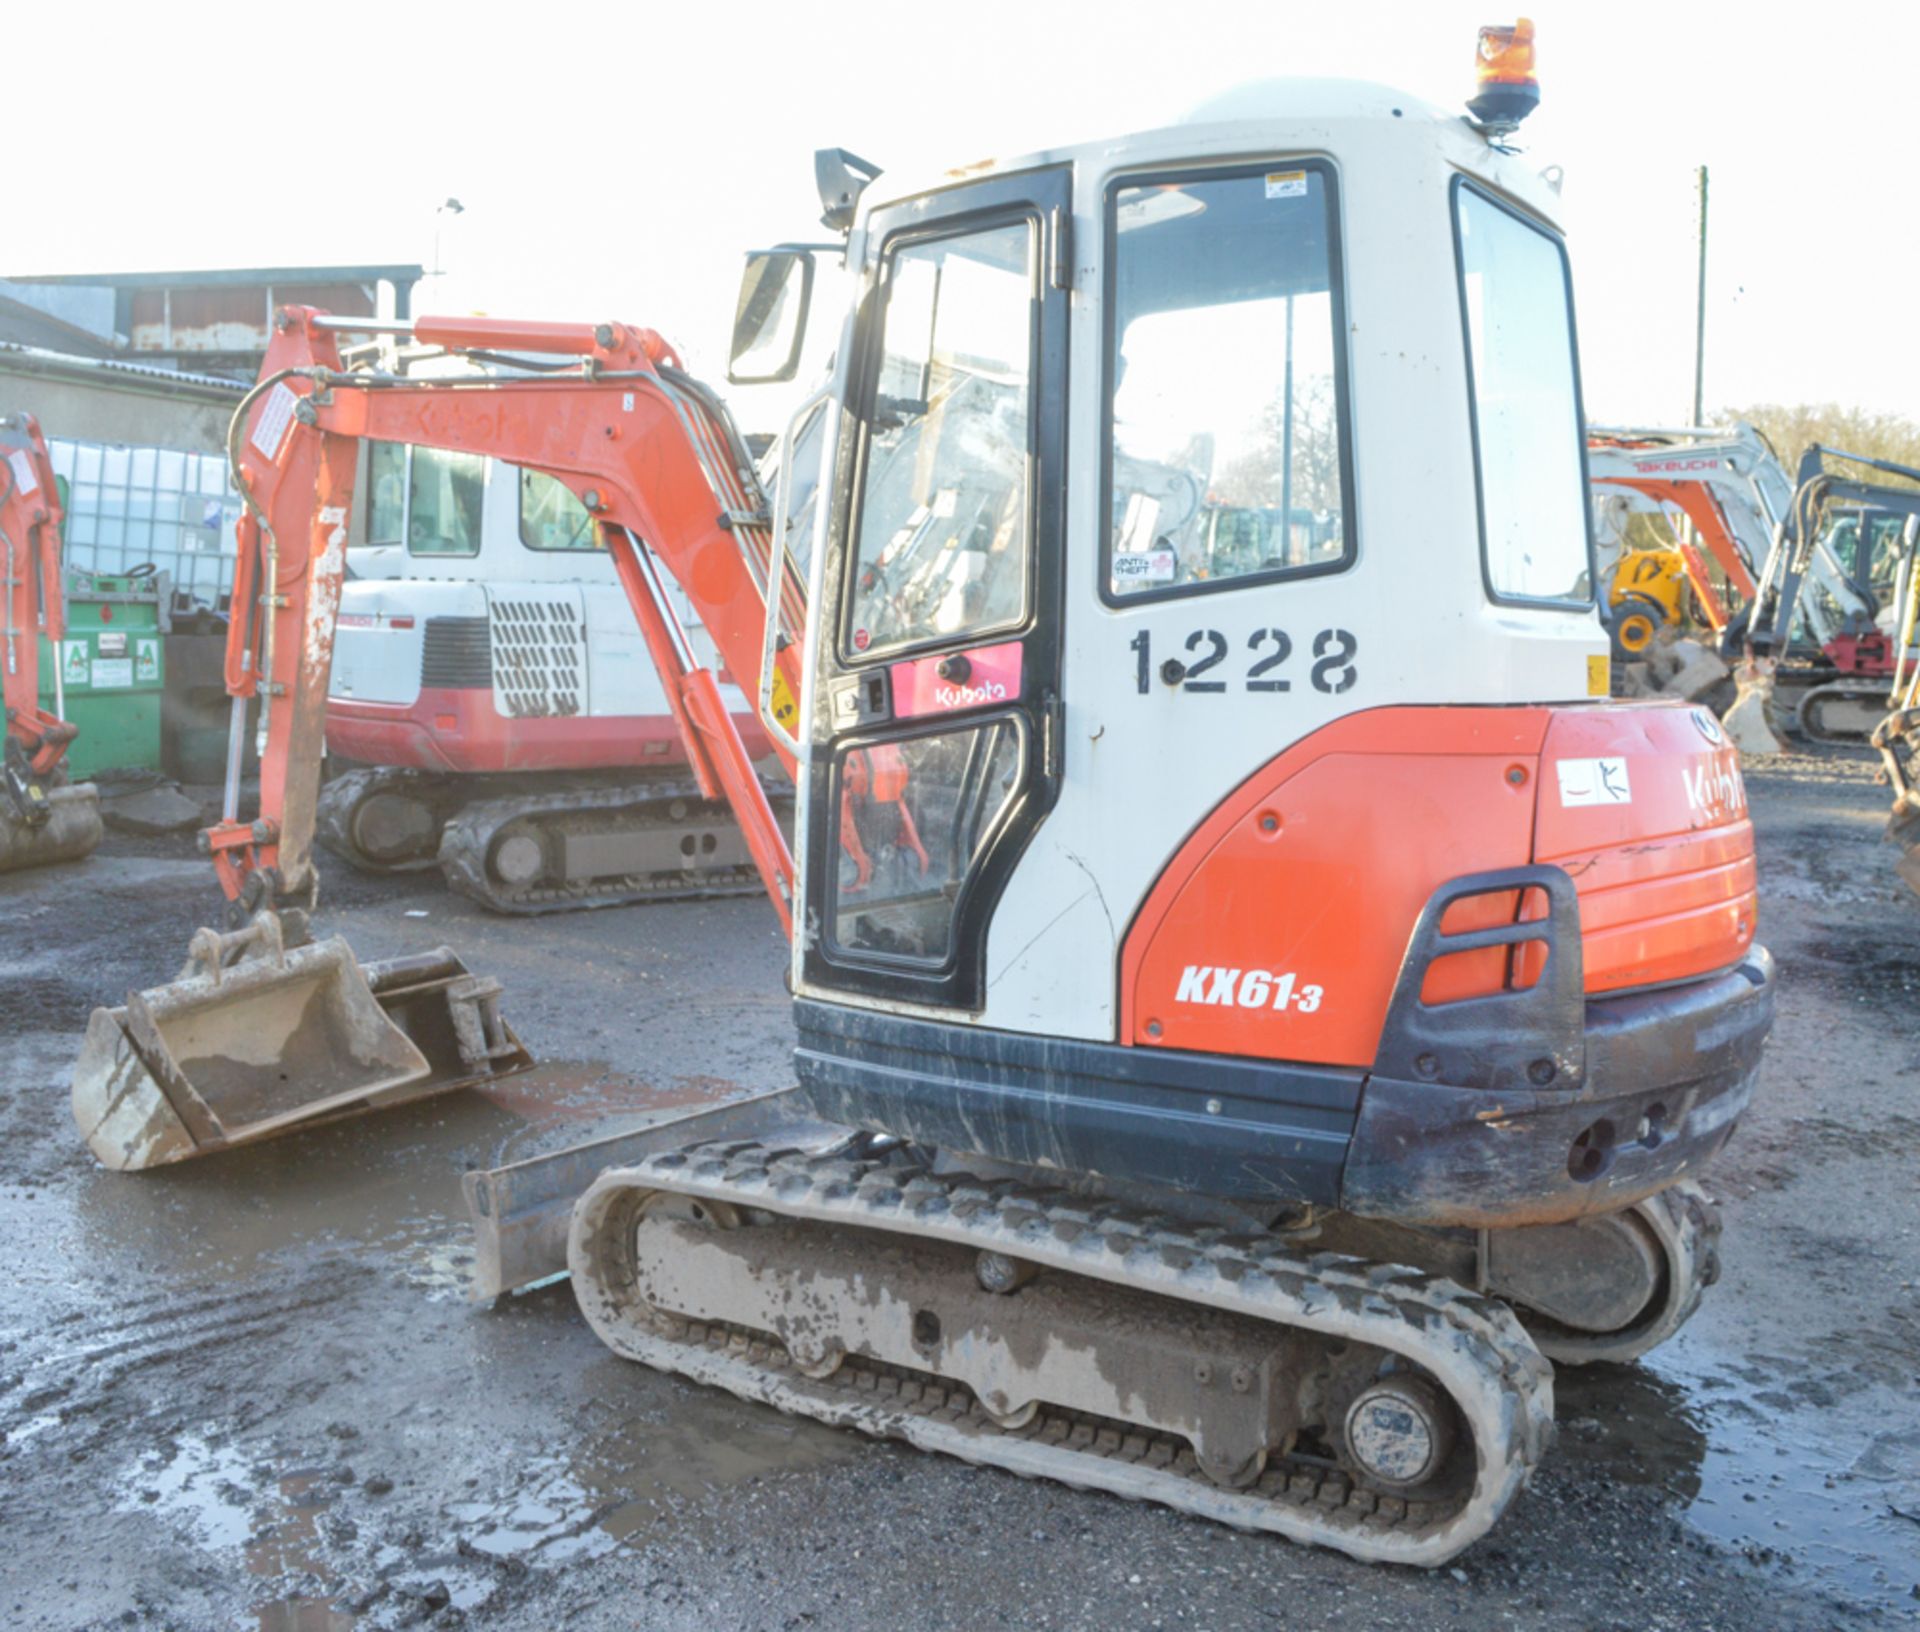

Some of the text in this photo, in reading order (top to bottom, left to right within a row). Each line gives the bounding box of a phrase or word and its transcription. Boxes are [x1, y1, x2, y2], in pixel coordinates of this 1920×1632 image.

[1130, 628, 1358, 694] 1228
[936, 680, 1006, 706] Kubota
[1175, 965, 1324, 1013] KX61-3
